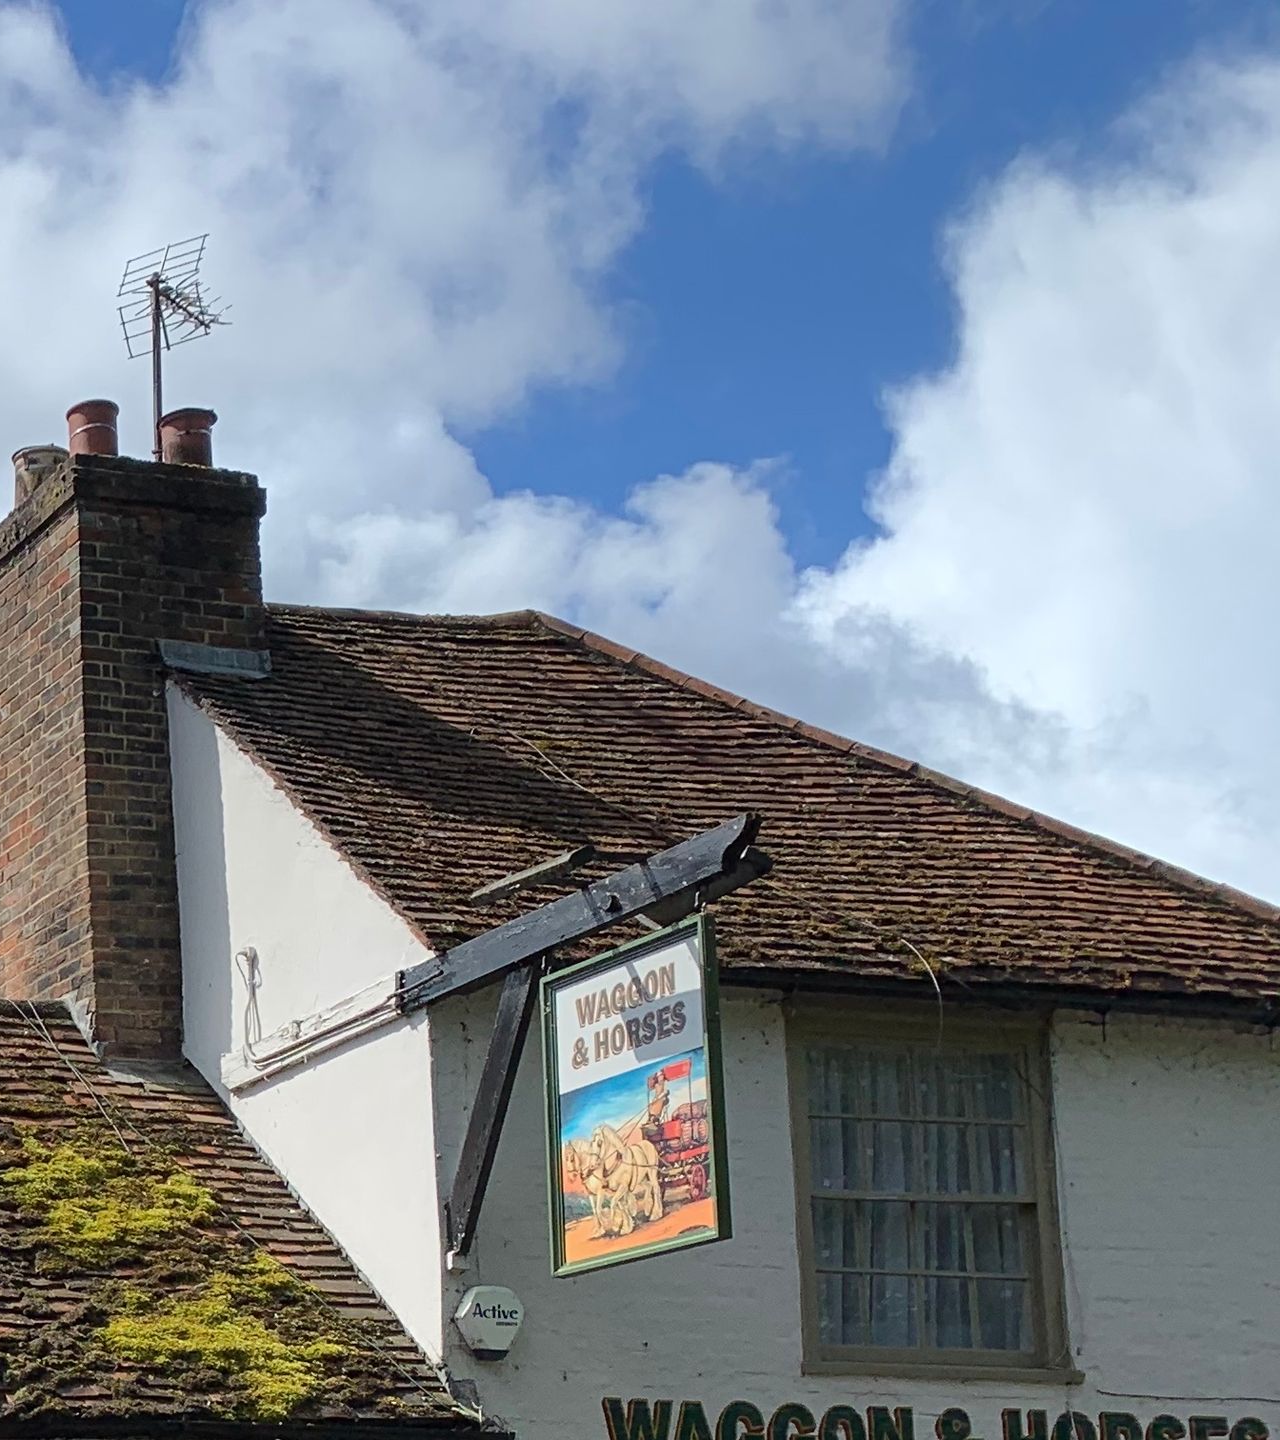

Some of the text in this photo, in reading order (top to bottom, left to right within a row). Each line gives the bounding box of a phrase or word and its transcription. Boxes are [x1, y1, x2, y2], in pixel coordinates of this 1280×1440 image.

[575, 962, 676, 1029] WAGGON
[572, 1001, 687, 1070] & HORSES
[472, 1302, 519, 1319] Active
